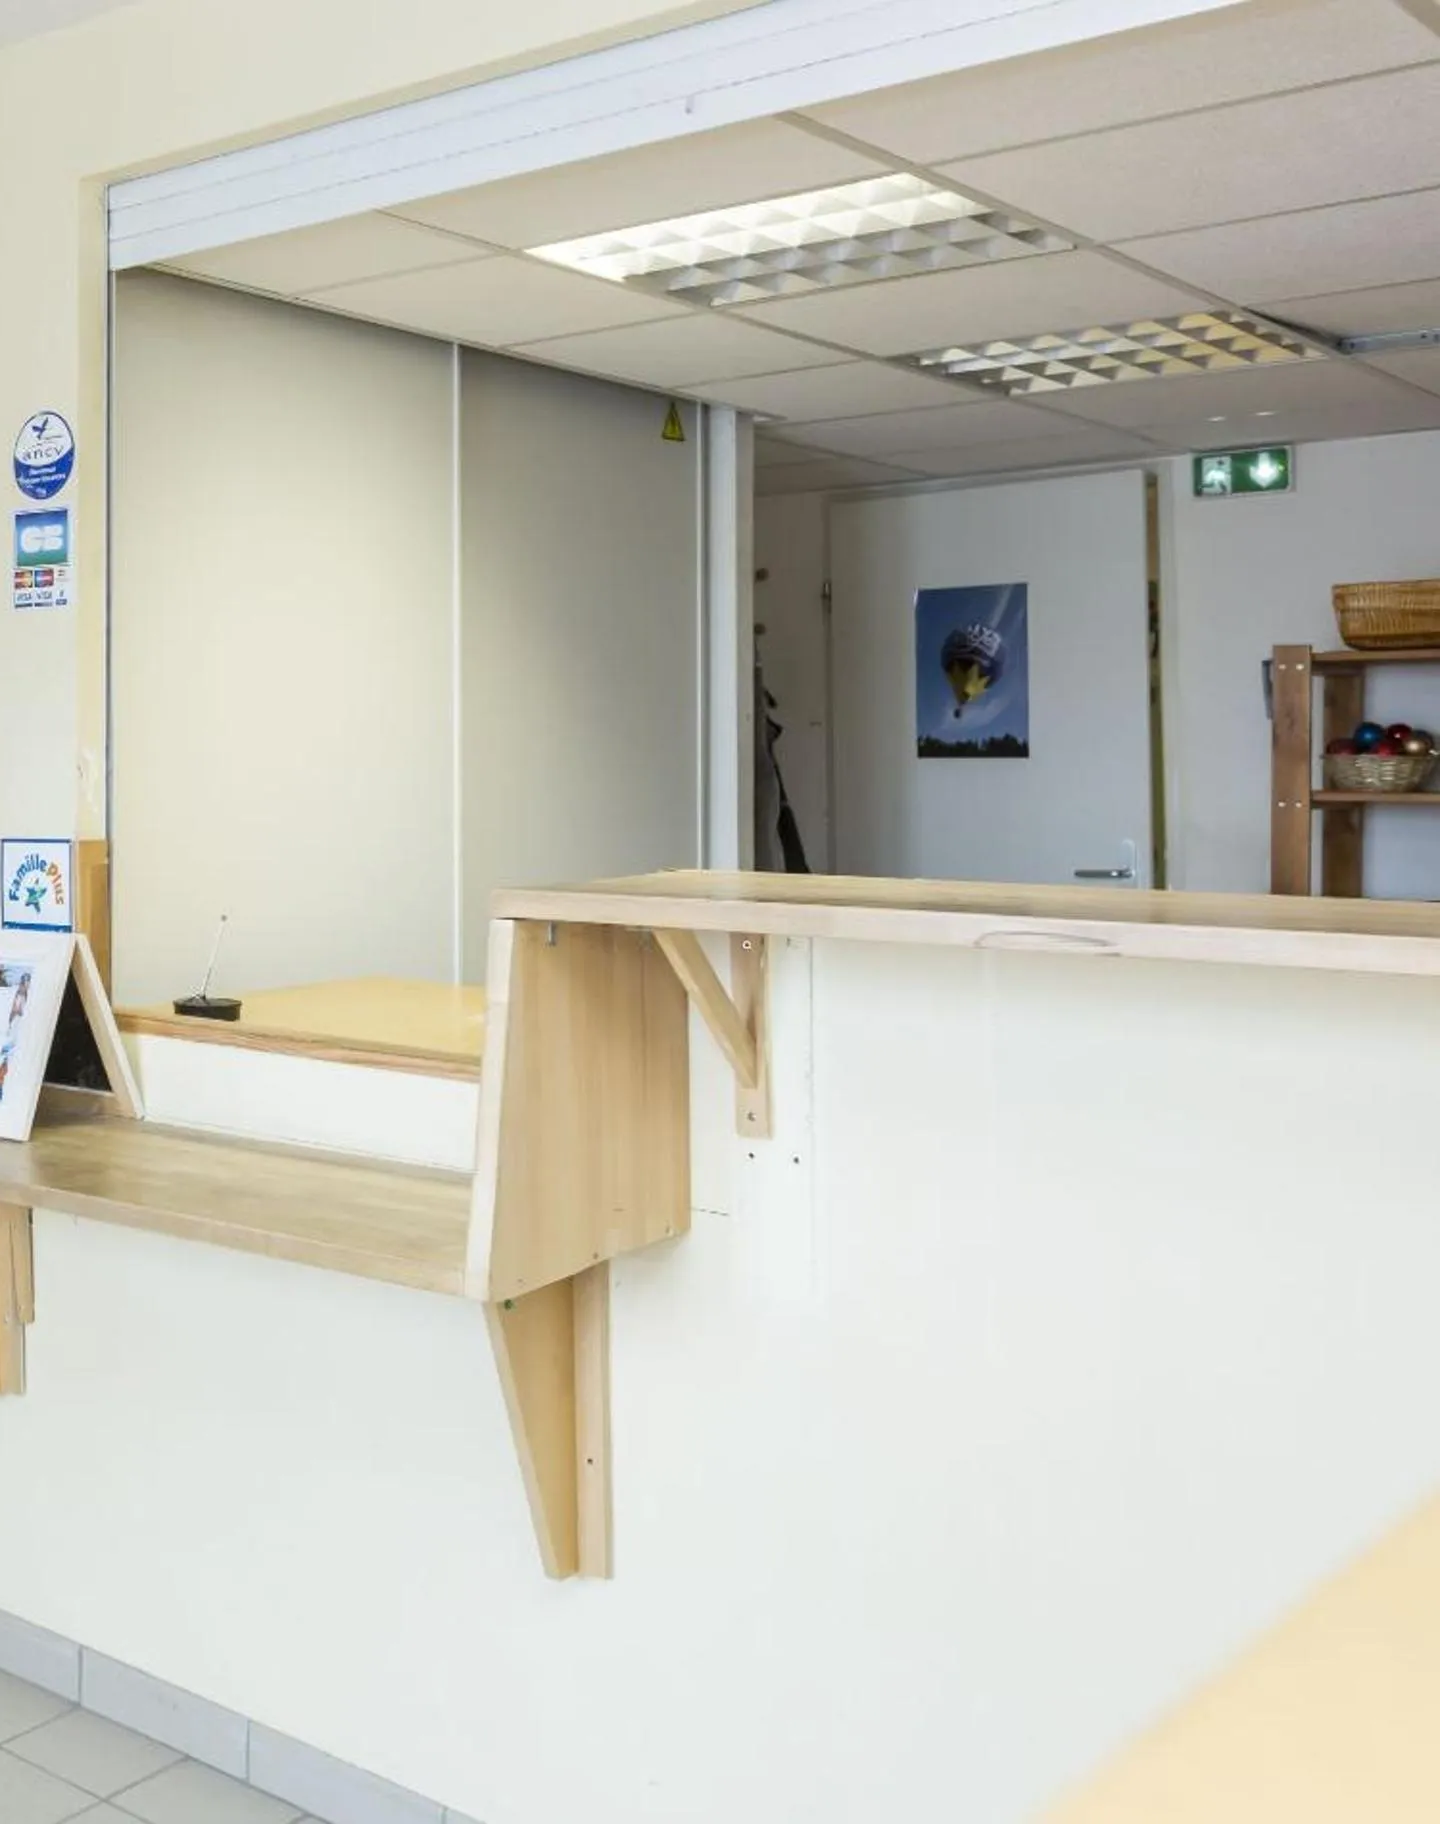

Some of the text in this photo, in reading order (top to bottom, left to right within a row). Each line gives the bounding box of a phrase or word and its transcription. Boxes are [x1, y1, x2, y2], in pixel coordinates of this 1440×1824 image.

[21, 445, 64, 461] ancv
[21, 525, 63, 553] CB
[8, 853, 47, 901] Famille
